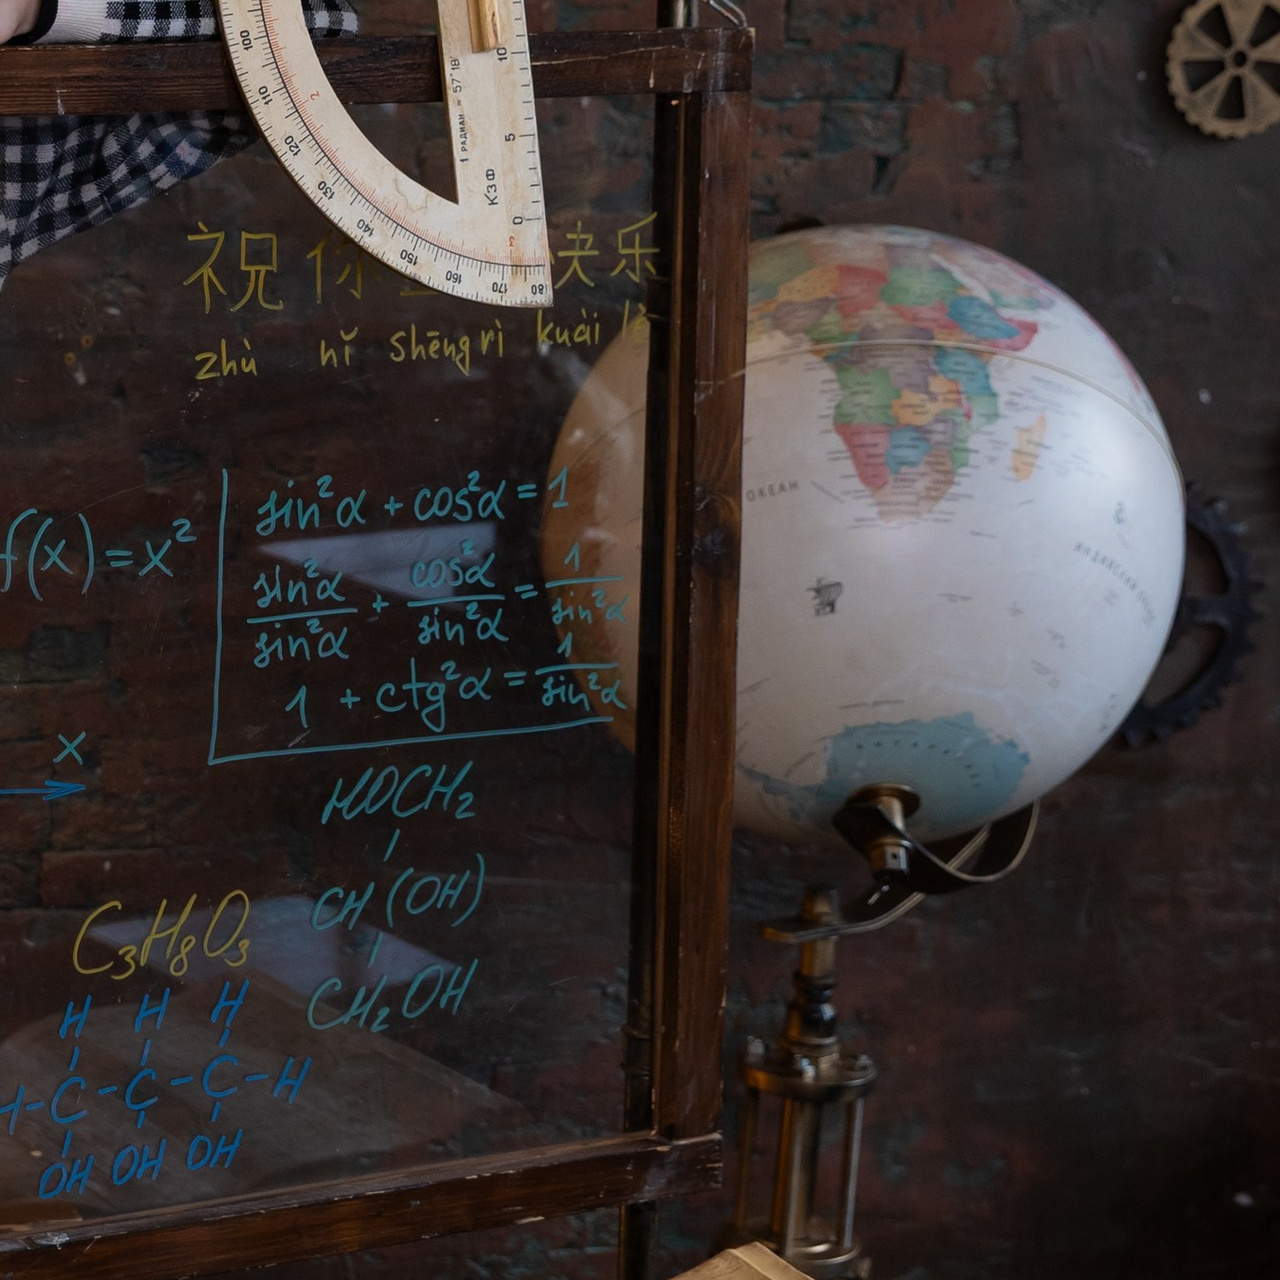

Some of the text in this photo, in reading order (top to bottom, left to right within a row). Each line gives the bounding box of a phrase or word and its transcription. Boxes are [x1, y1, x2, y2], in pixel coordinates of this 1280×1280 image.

[240, 29, 253, 51] 100
[496, 46, 508, 63] 10
[258, 85, 273, 105] 110
[457, 113, 467, 152] РАДИАН
[505, 132, 516, 143] 5
[284, 134, 301, 157] 120
[317, 180, 336, 201] 130
[484, 169, 498, 206] КЗФ
[357, 218, 375, 237] 140
[512, 215, 524, 226] 0
[400, 249, 418, 266] 150
[445, 270, 462, 285] 160
[491, 281, 508, 293] 170
[38, 1128, 243, 1200] OH OH OH
